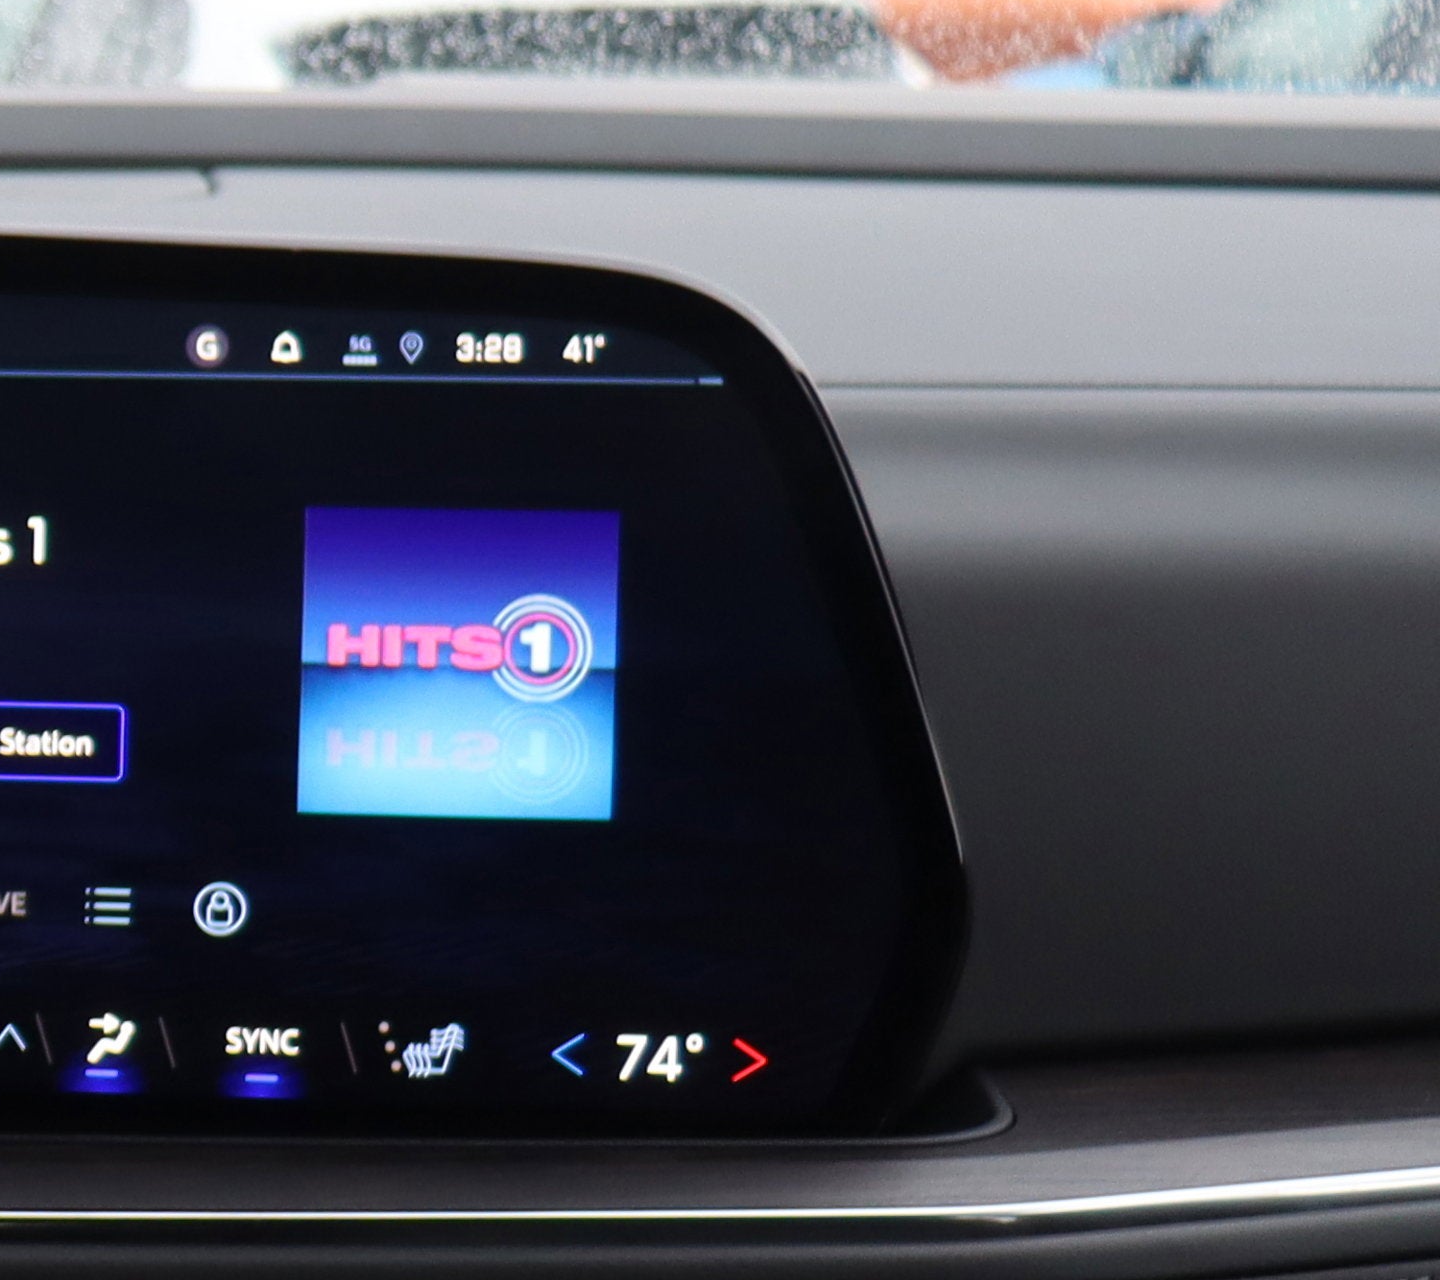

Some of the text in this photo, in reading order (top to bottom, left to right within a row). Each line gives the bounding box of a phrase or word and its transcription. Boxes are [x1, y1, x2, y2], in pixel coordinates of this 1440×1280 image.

[455, 332, 524, 363] 3:28
[27, 515, 48, 565] 1
[327, 622, 552, 674] HITS 1
[224, 1024, 301, 1056] SYNC
[615, 1032, 705, 1084] 74°
